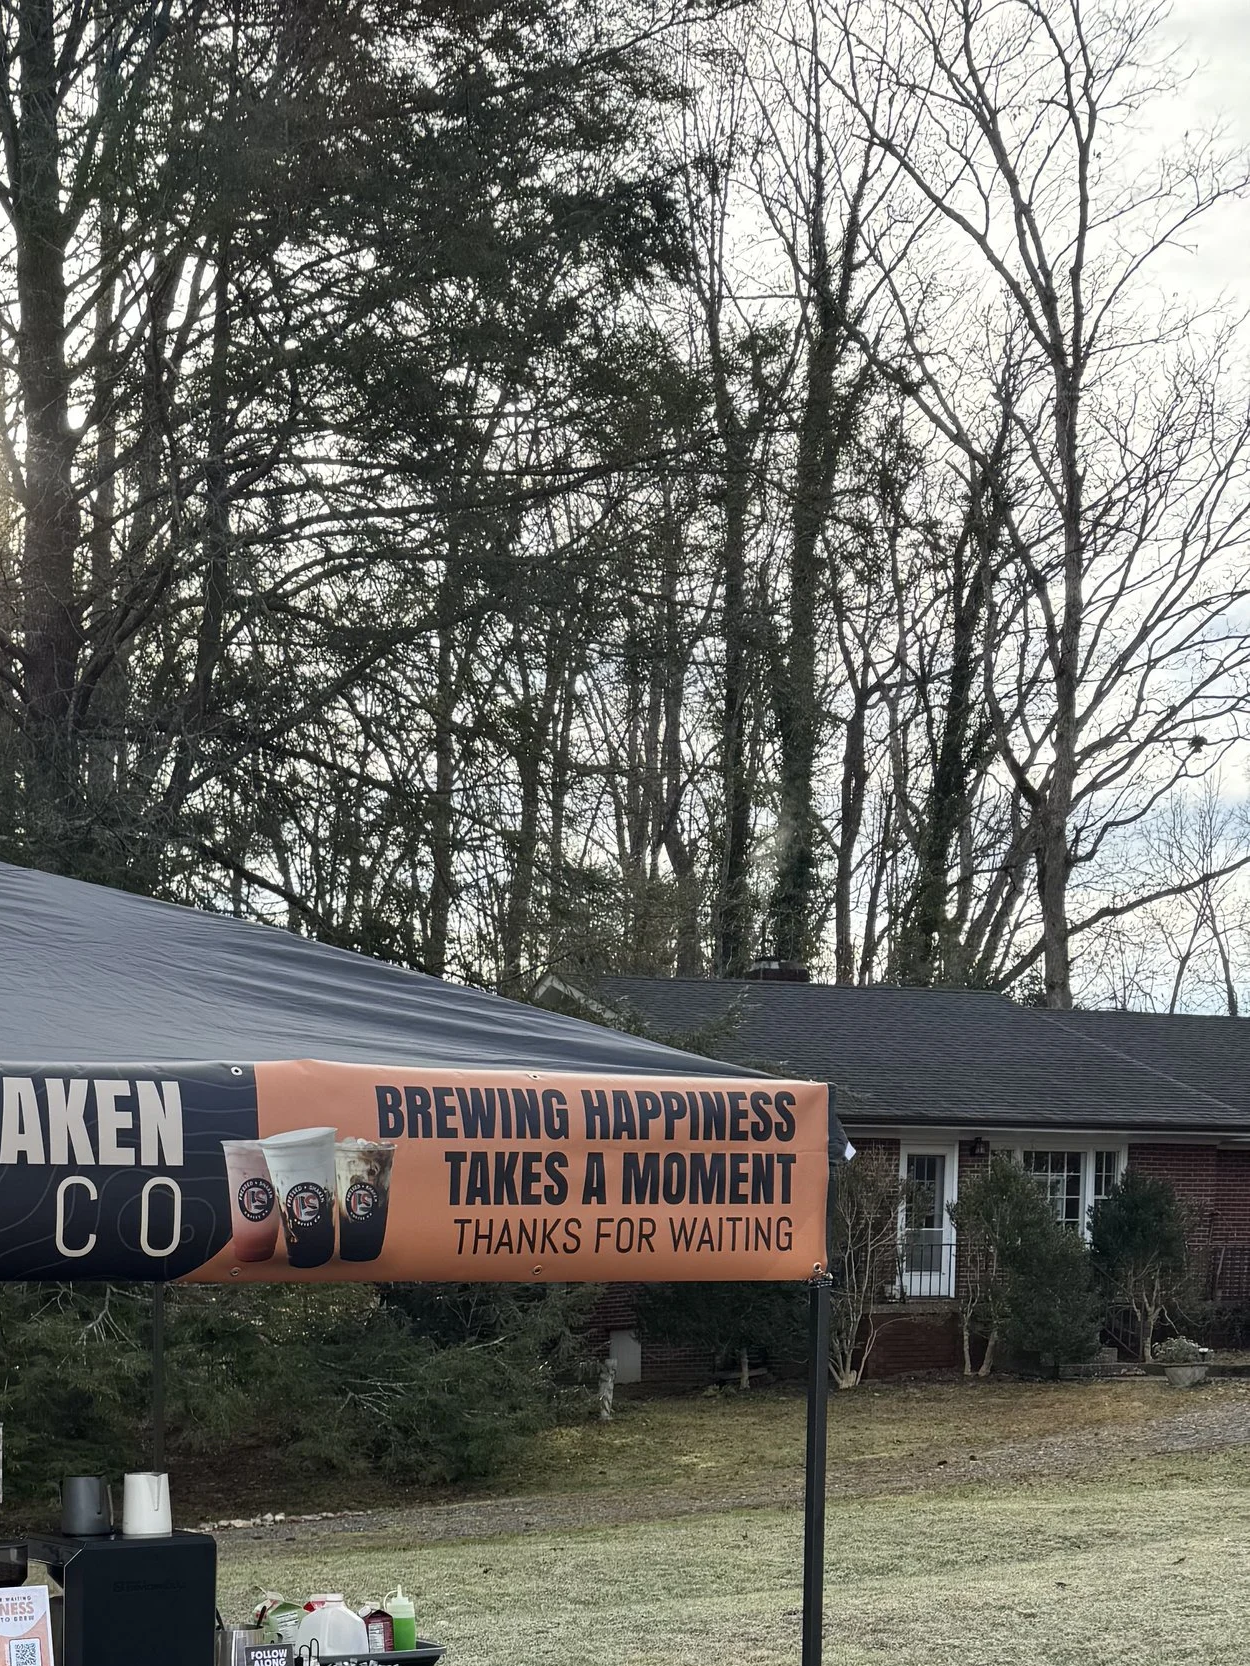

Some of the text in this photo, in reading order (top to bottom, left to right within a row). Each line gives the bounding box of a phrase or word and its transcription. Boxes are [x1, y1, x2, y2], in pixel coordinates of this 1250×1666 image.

[374, 1085, 797, 1143] BREWING HAPPINESS
[444, 1150, 797, 1206] TAKES A MOMENT
[54, 1174, 183, 1258] CO
[453, 1216, 794, 1256] THANKS FOR WAITING
[250, 1649, 287, 1660] FOLLOW
